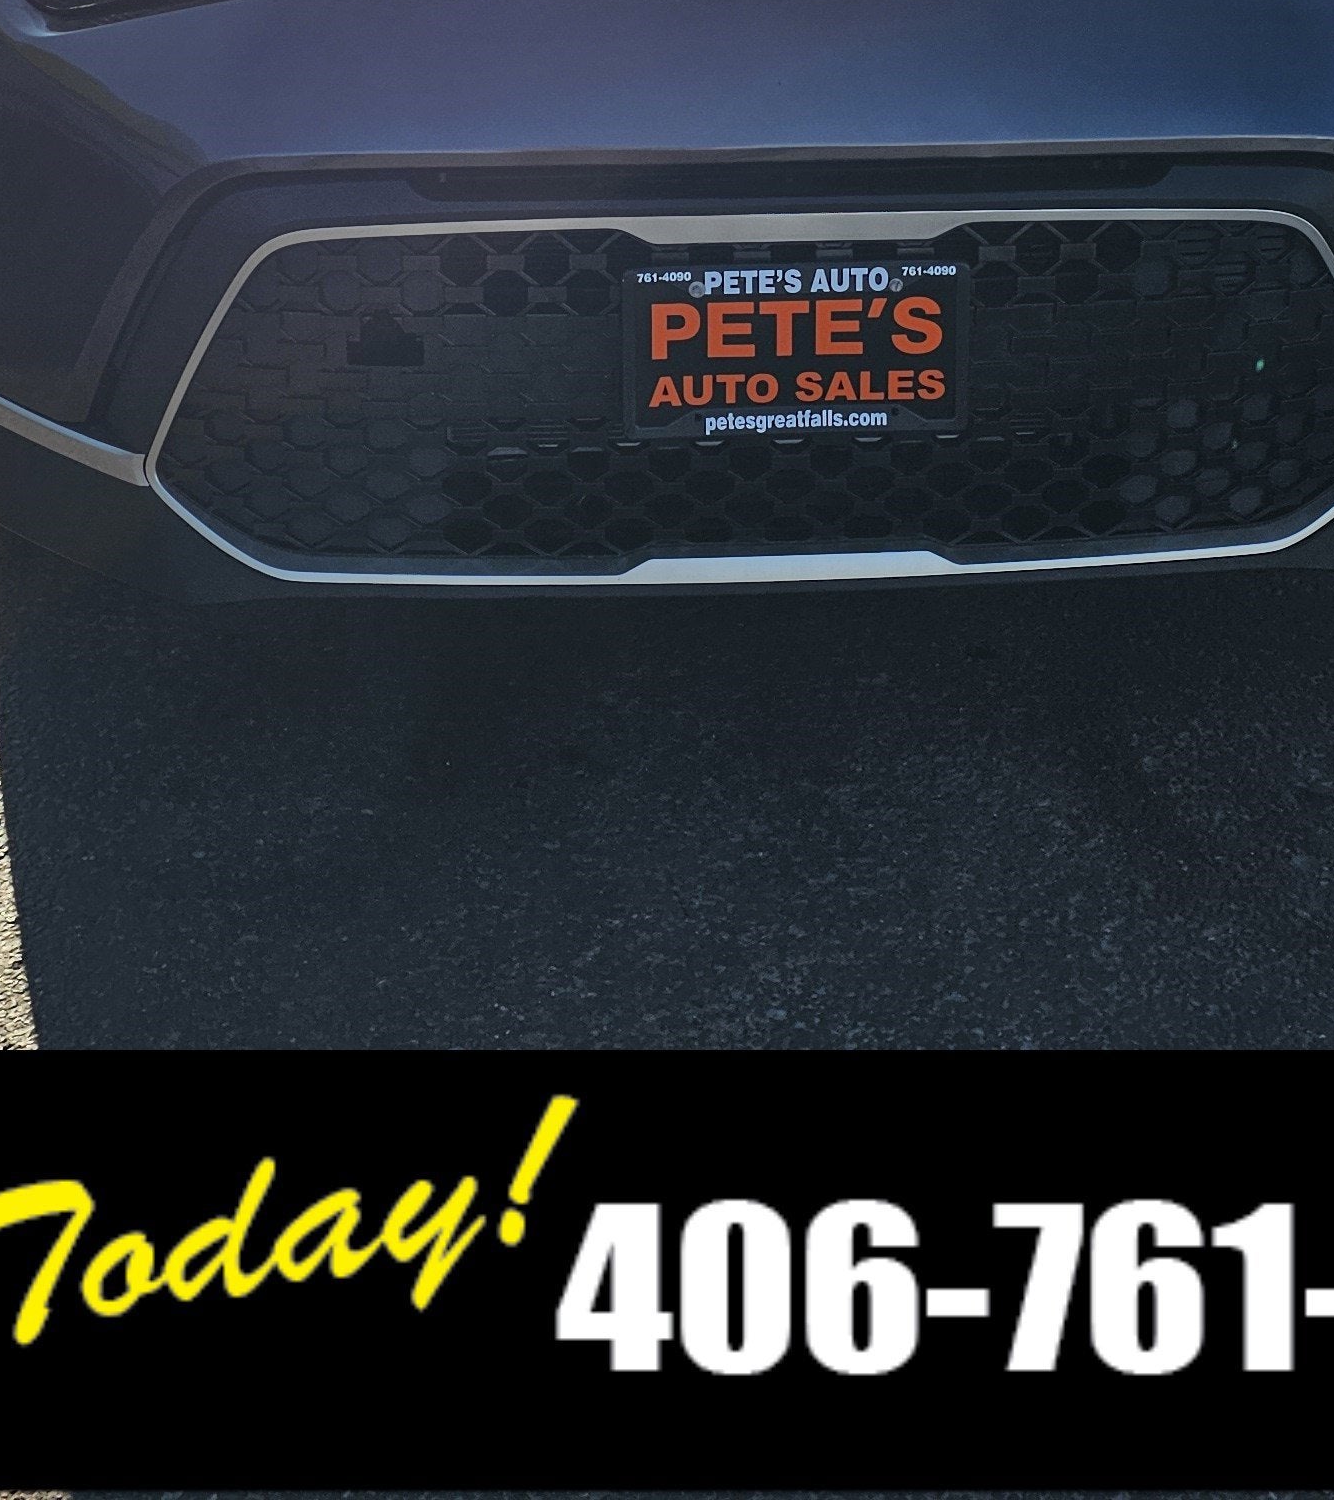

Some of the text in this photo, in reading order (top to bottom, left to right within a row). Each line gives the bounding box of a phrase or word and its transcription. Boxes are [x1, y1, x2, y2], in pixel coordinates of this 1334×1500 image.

[636, 271, 692, 283] 761-4090
[704, 266, 890, 295] PETE'S AUTO
[901, 265, 957, 277] 761-4090
[650, 296, 944, 360] PETE'S
[649, 369, 946, 408] AUTO SALES
[705, 409, 888, 435] petesgreatfalls.com
